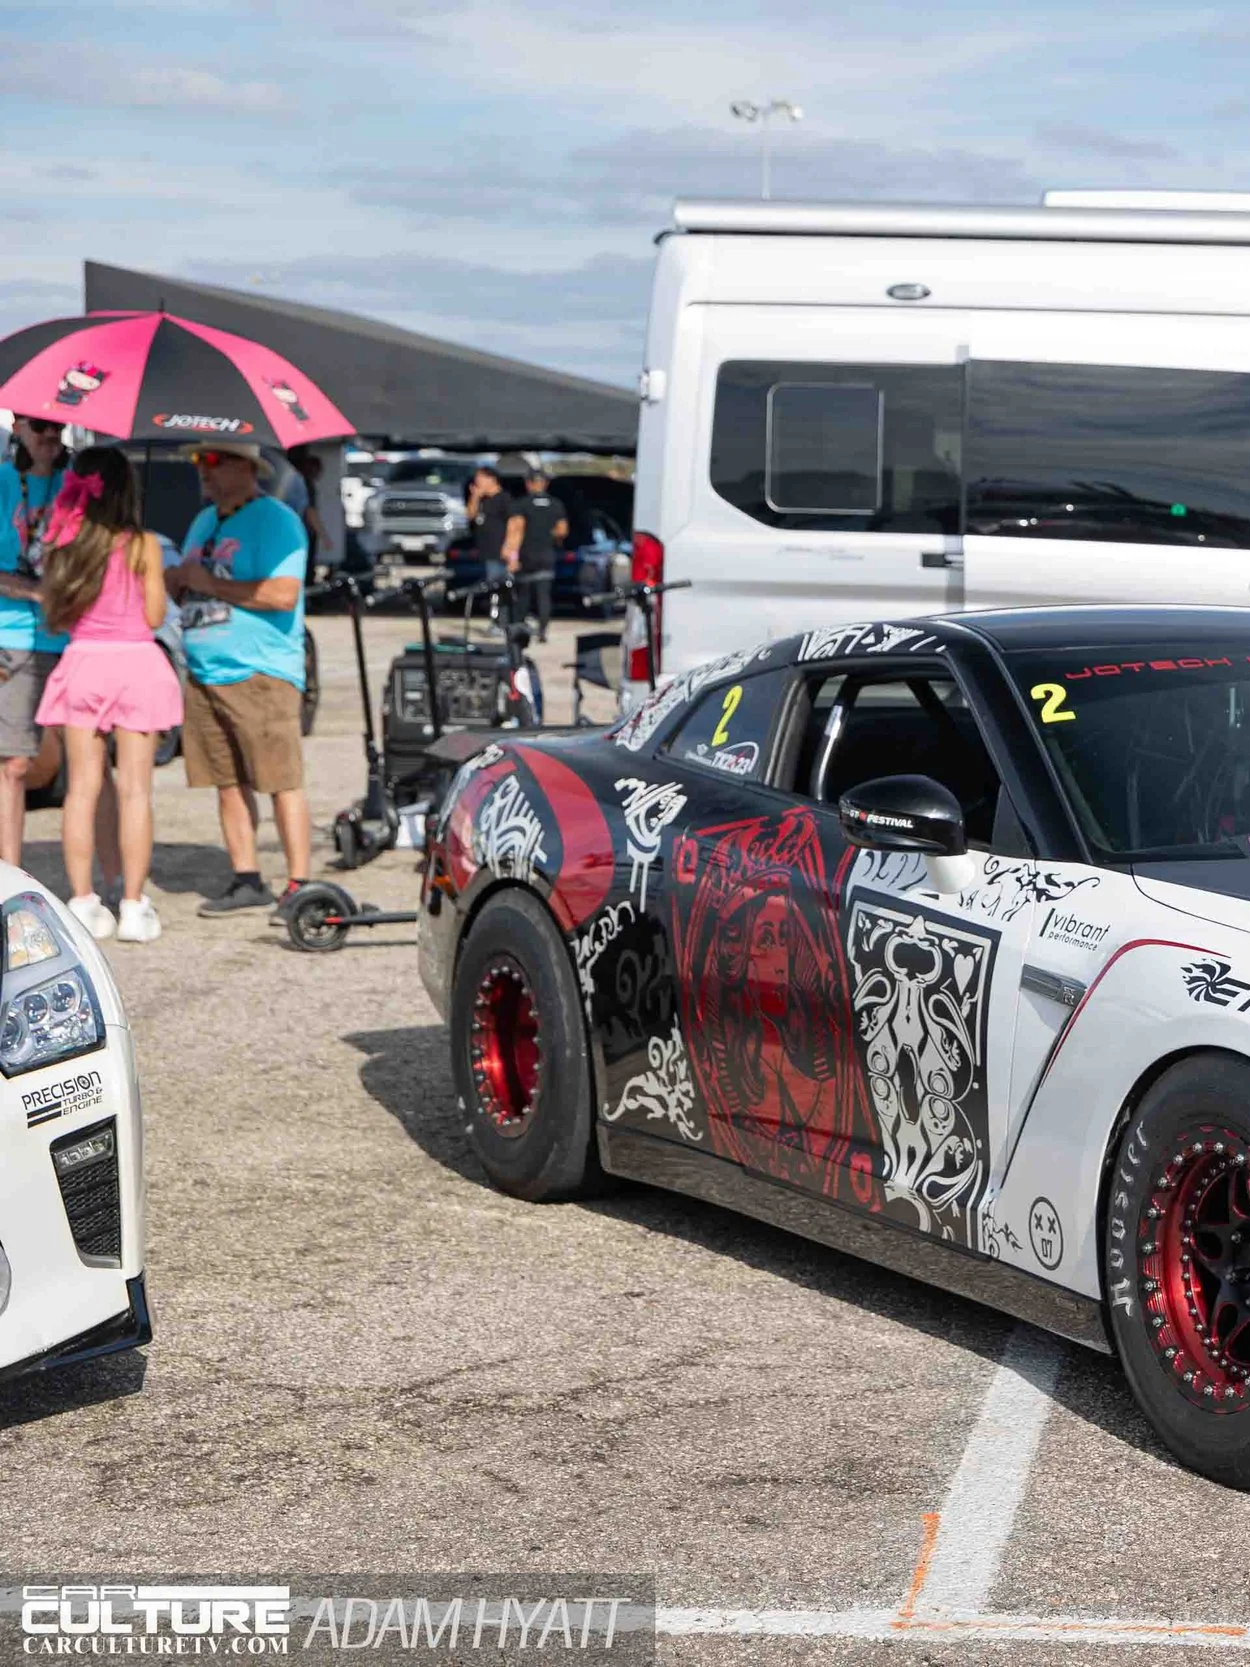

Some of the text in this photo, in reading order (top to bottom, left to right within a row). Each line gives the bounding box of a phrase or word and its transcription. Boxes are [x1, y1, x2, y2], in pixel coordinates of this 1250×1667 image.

[164, 413, 240, 432] JOTECH
[1065, 657, 1232, 680] JOTECH
[1030, 682, 1077, 724] 2
[711, 685, 743, 748] 2
[867, 814, 914, 829] FESTIVAL
[1053, 913, 1111, 943] vibrant
[1047, 930, 1098, 952] performance
[21, 1070, 102, 1111] PRECISION
[63, 1089, 95, 1107] TURBO
[62, 1095, 103, 1116] ENGINE
